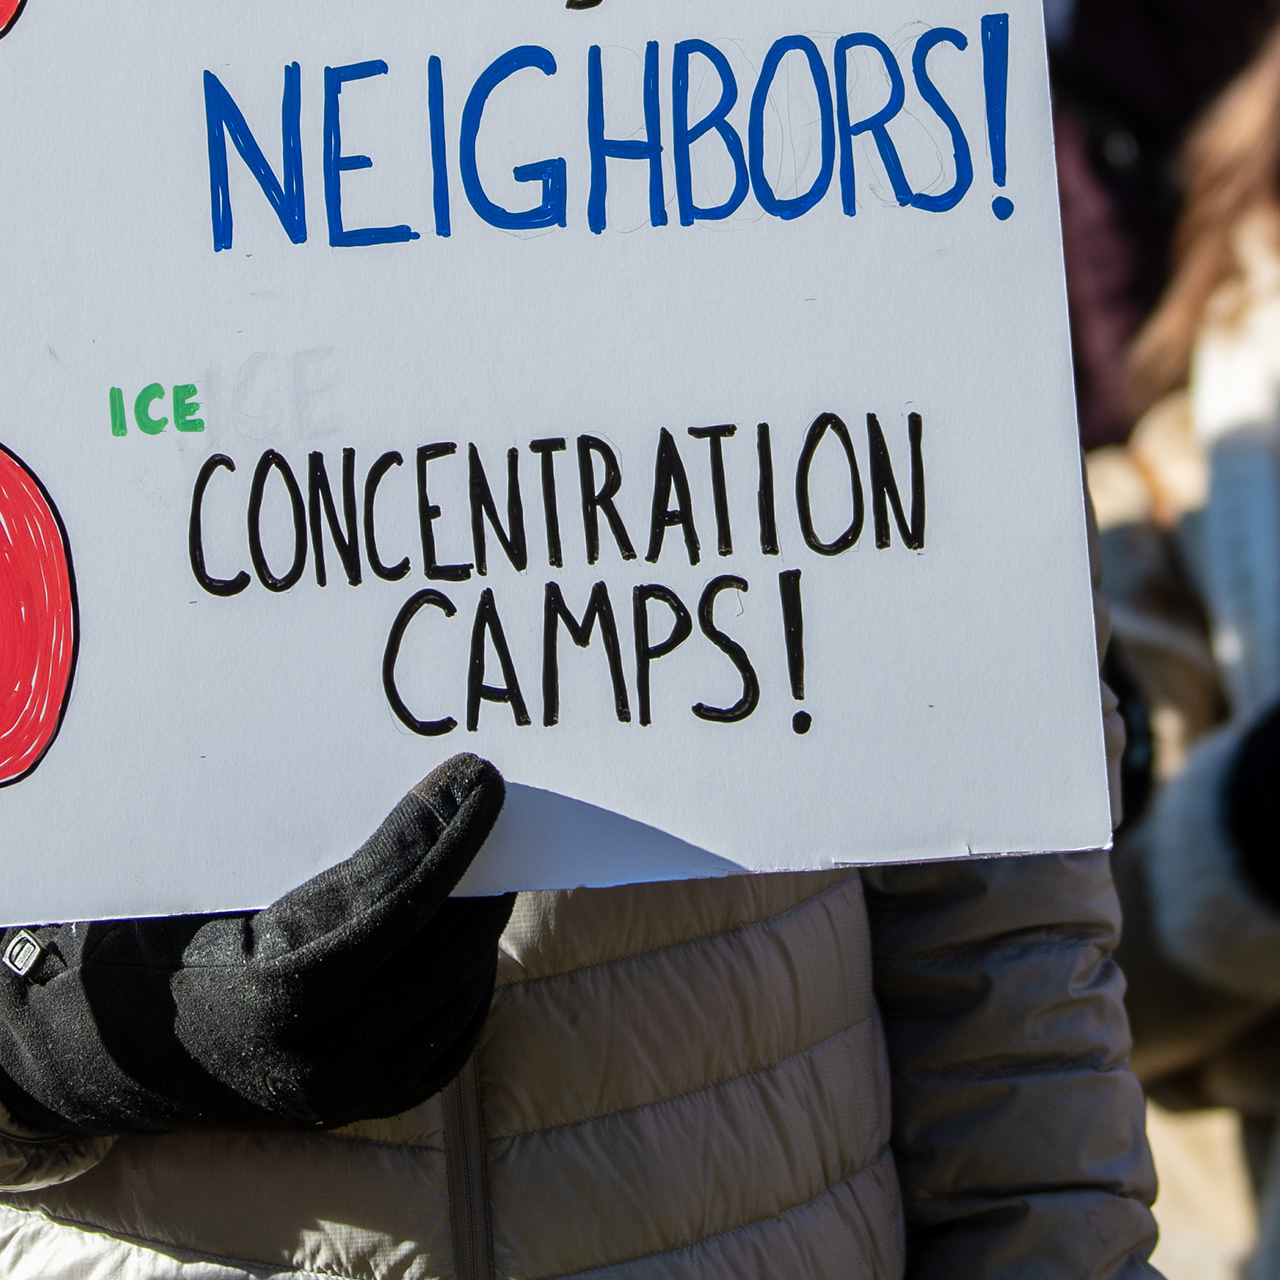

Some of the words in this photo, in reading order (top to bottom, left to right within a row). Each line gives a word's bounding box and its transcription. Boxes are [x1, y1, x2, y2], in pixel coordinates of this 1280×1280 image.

[203, 12, 1013, 253] NEIGHBORS!
[108, 382, 205, 437] ICE
[189, 411, 926, 596] CONCENTRATION
[383, 569, 814, 737] CAMPS!
